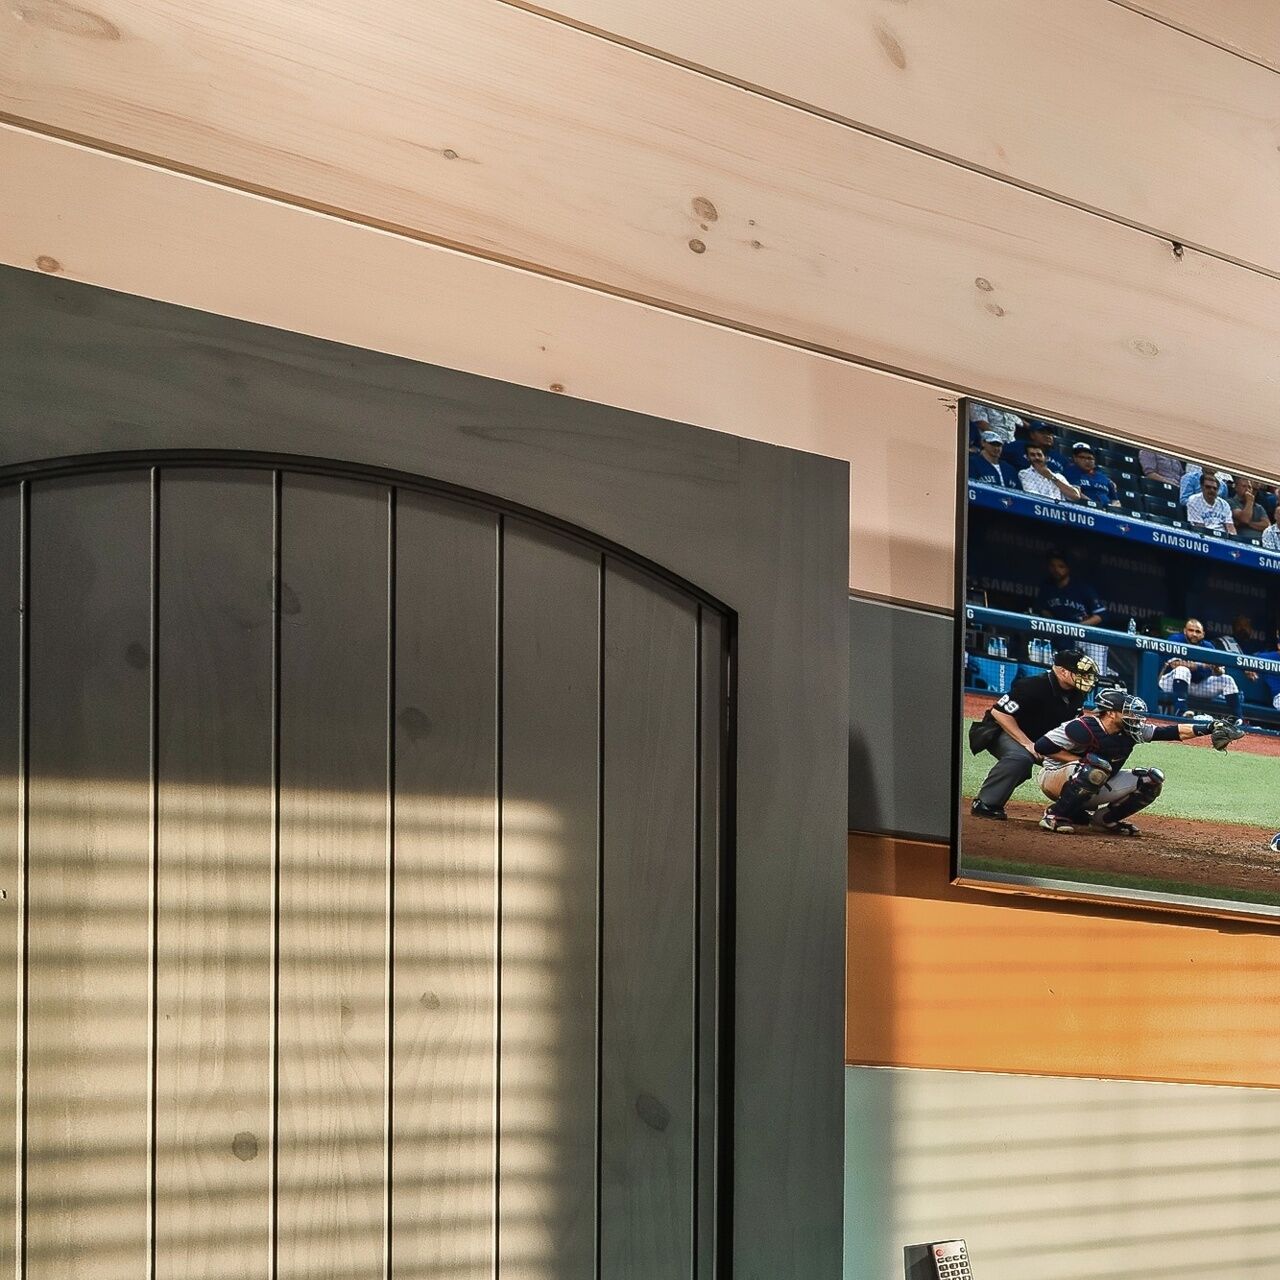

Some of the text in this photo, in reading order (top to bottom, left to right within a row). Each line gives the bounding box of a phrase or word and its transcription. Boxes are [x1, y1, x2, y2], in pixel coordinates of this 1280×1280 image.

[1034, 504, 1095, 527] SAMSUNG
[1152, 531, 1210, 554] SAMSUNG
[1031, 620, 1086, 638] SAMSUNG
[1135, 638, 1188, 656] SAMSUNG
